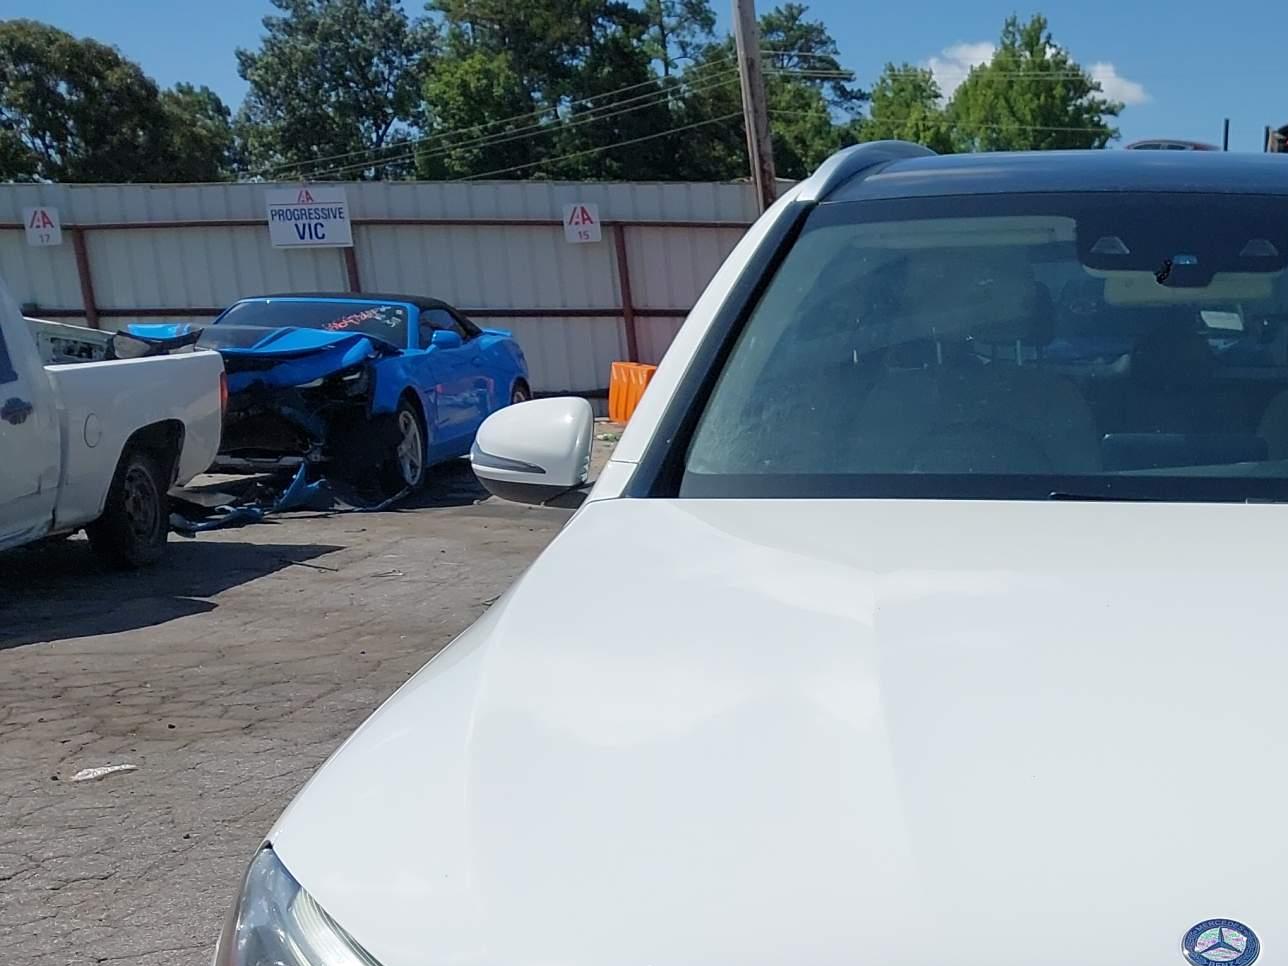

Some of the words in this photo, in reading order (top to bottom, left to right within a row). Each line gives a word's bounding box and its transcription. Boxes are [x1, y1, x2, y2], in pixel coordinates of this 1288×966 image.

[270, 207, 345, 221] PROGRESSIVE
[294, 222, 326, 241] VIC
[577, 230, 590, 241] 15
[40, 233, 50, 244] 17
